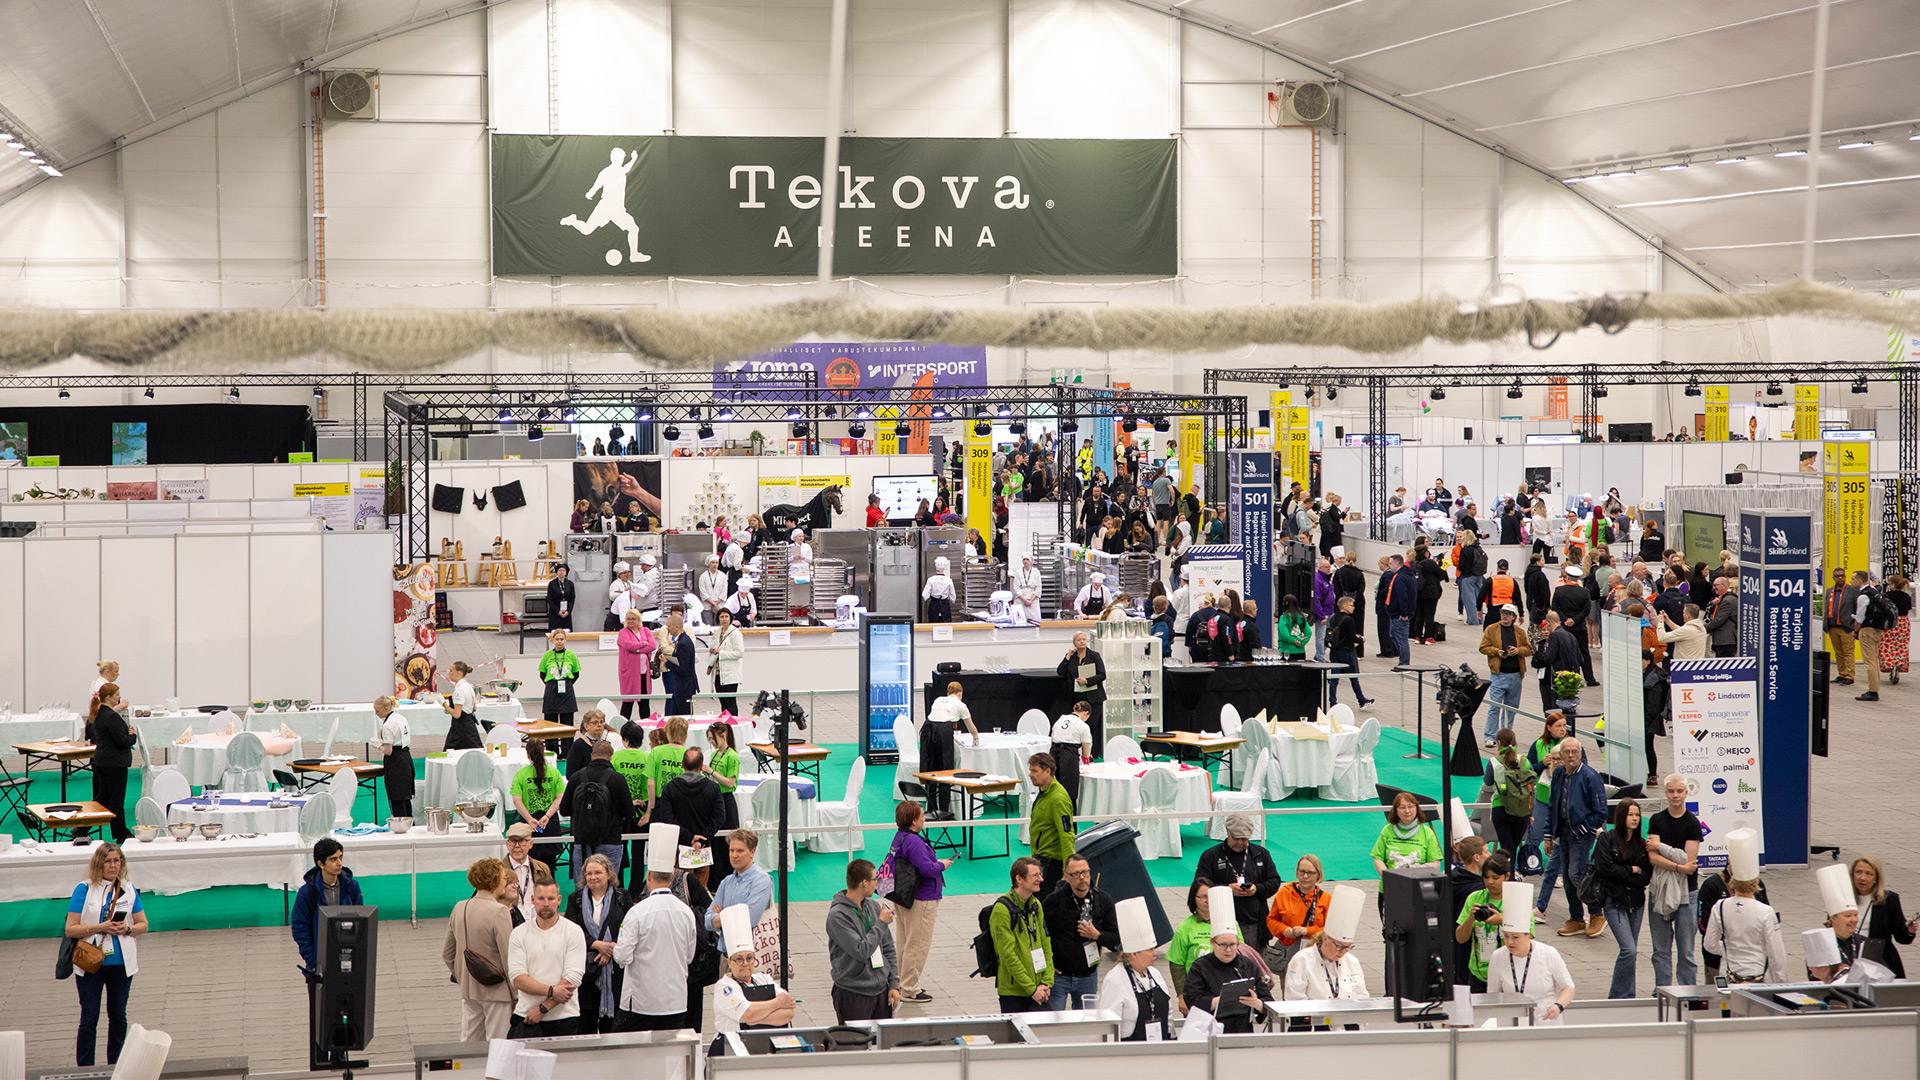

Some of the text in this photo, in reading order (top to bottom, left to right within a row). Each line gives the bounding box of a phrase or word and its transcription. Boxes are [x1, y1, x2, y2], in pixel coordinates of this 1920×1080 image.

[729, 165, 1030, 209] Tekova
[882, 360, 978, 378] INTERSPORT
[880, 434, 896, 442] 307
[1291, 433, 1306, 441] 303
[972, 449, 988, 458] 309
[1842, 482, 1866, 493] 305
[1244, 493, 1268, 505] 501
[606, 521, 612, 530] 6
[1742, 576, 1760, 596] 504
[1768, 579, 1806, 597] 504
[1782, 607, 1791, 647] Servitör
[1792, 607, 1803, 651] Tarjoilija
[1769, 607, 1779, 701] Restaurant Service
[1683, 692, 1692, 700] K
[1061, 720, 1070, 730] 3
[620, 762, 645, 770] STAFF
[661, 759, 682, 768] STAF
[1723, 764, 1749, 772] palmia
